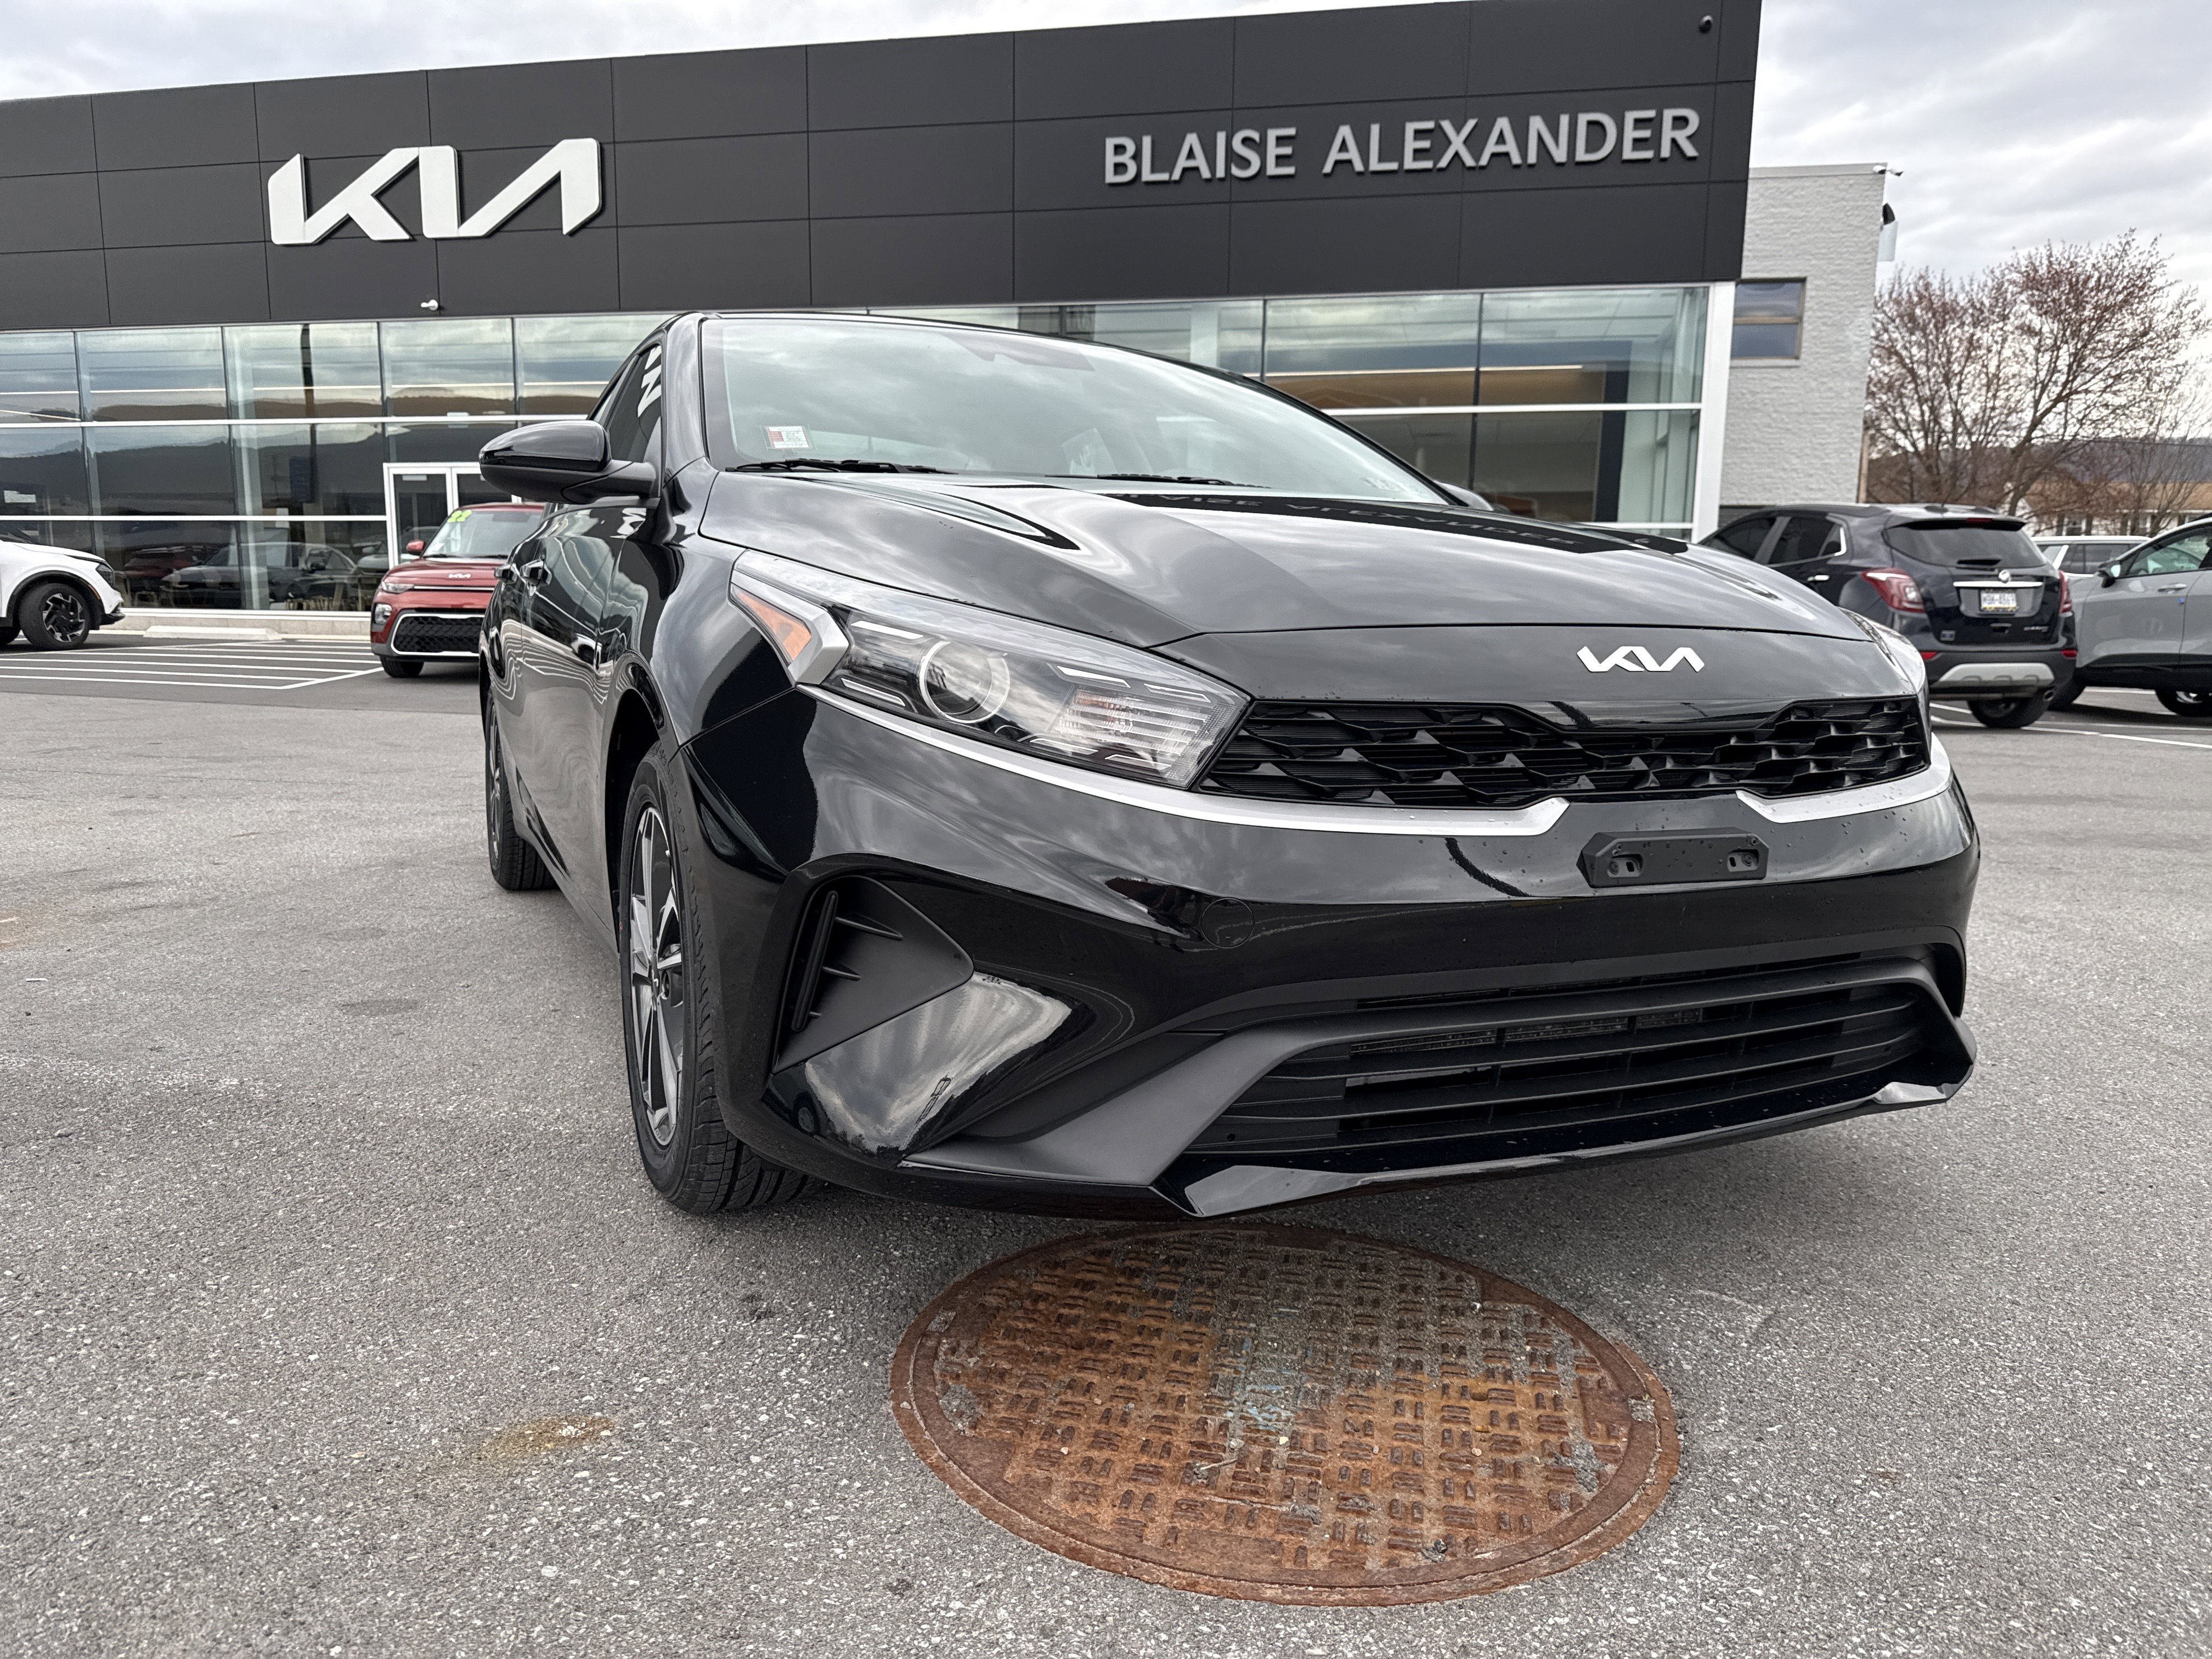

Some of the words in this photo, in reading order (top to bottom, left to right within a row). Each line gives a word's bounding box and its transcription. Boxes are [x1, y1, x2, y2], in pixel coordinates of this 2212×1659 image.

[1104, 127, 1297, 184] BLAISE
[1322, 108, 1700, 174] ALEXANDER
[268, 137, 601, 245] KIA
[447, 510, 472, 523] 22
[1577, 646, 1705, 673] KIA
